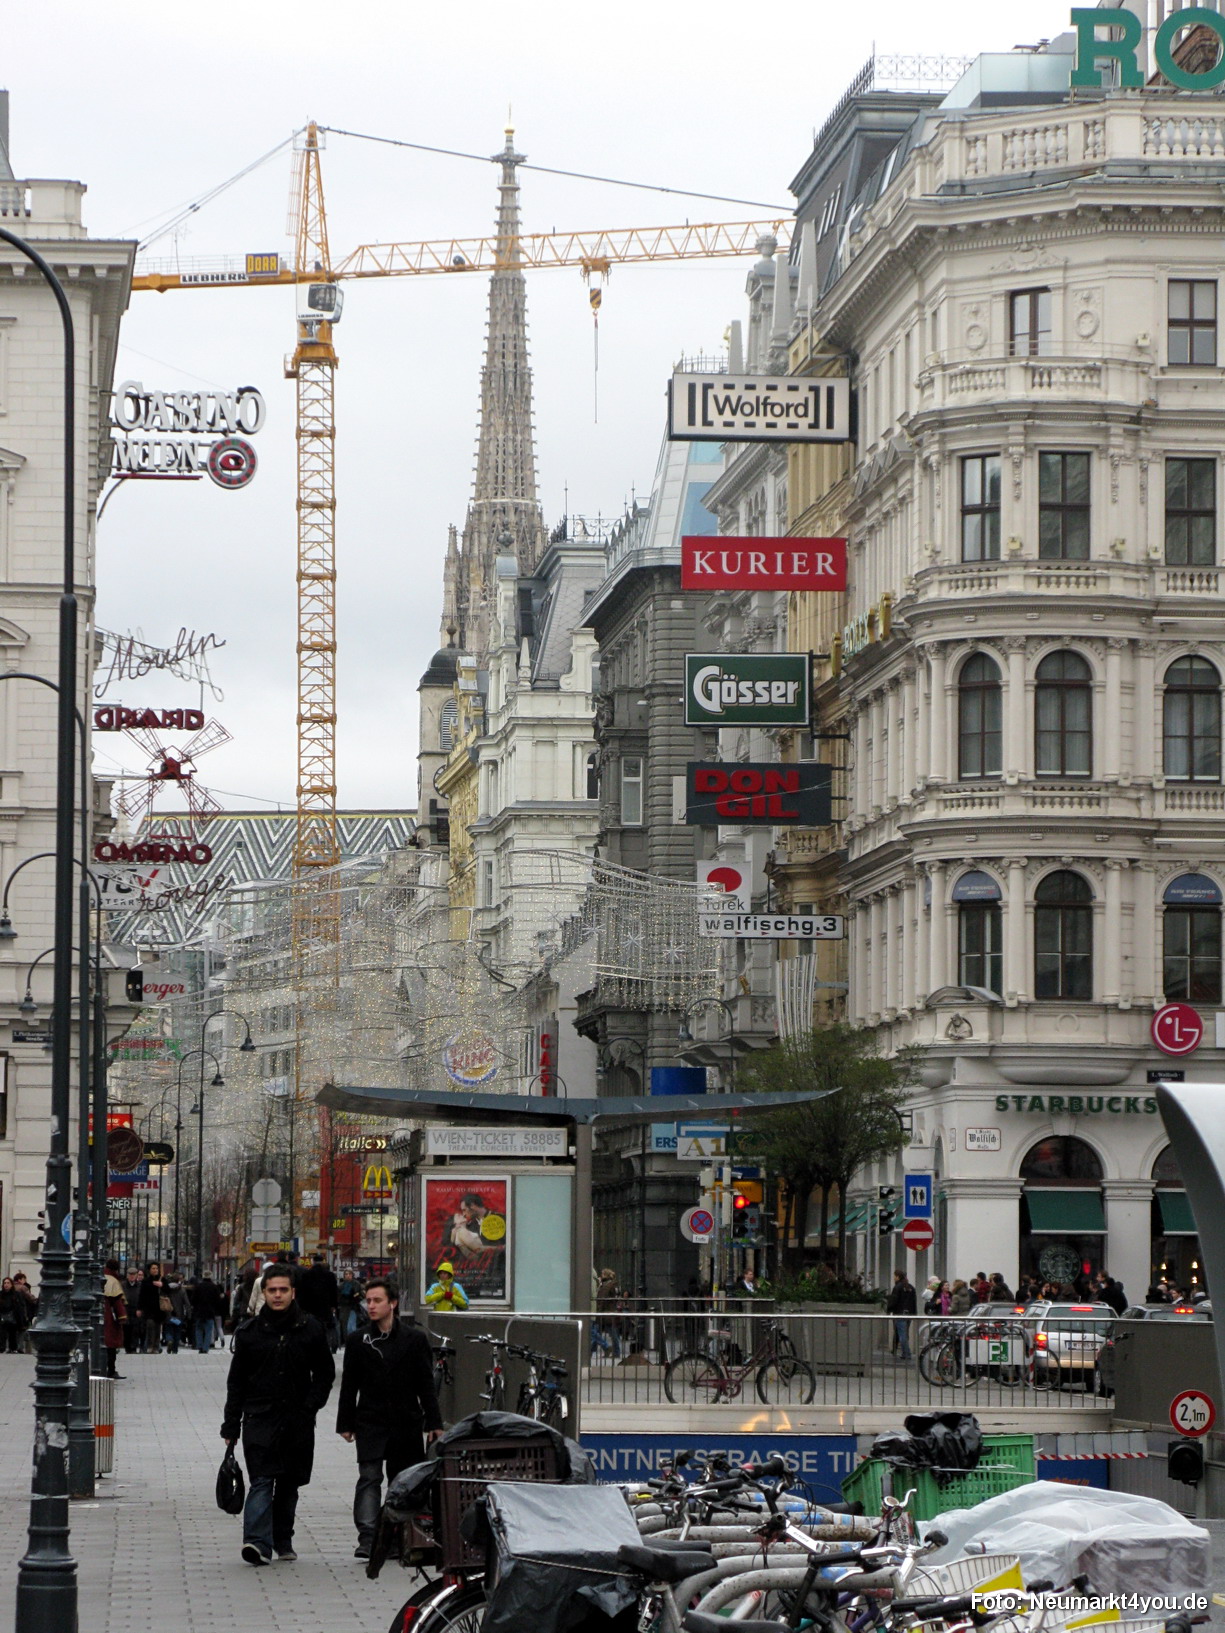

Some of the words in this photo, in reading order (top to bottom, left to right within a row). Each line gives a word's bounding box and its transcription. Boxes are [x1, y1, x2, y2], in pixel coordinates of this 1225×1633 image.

[182, 273, 248, 283] LIEBHERR
[115, 380, 267, 434] CASINO
[713, 394, 809, 419] Wolford
[115, 438, 200, 472] WIEN
[692, 550, 837, 576] KURIER
[692, 664, 800, 715] Gösser
[694, 769, 800, 793] DON
[715, 793, 800, 818] GIL
[1154, 1006, 1201, 1053] LG
[995, 1094, 1158, 1114] STARBUCKS
[433, 1132, 517, 1145] WIEN-TICKET
[523, 1133, 561, 1146] 58885
[682, 1137, 726, 1157] A1
[1180, 1403, 1206, 1423] 2,1m
